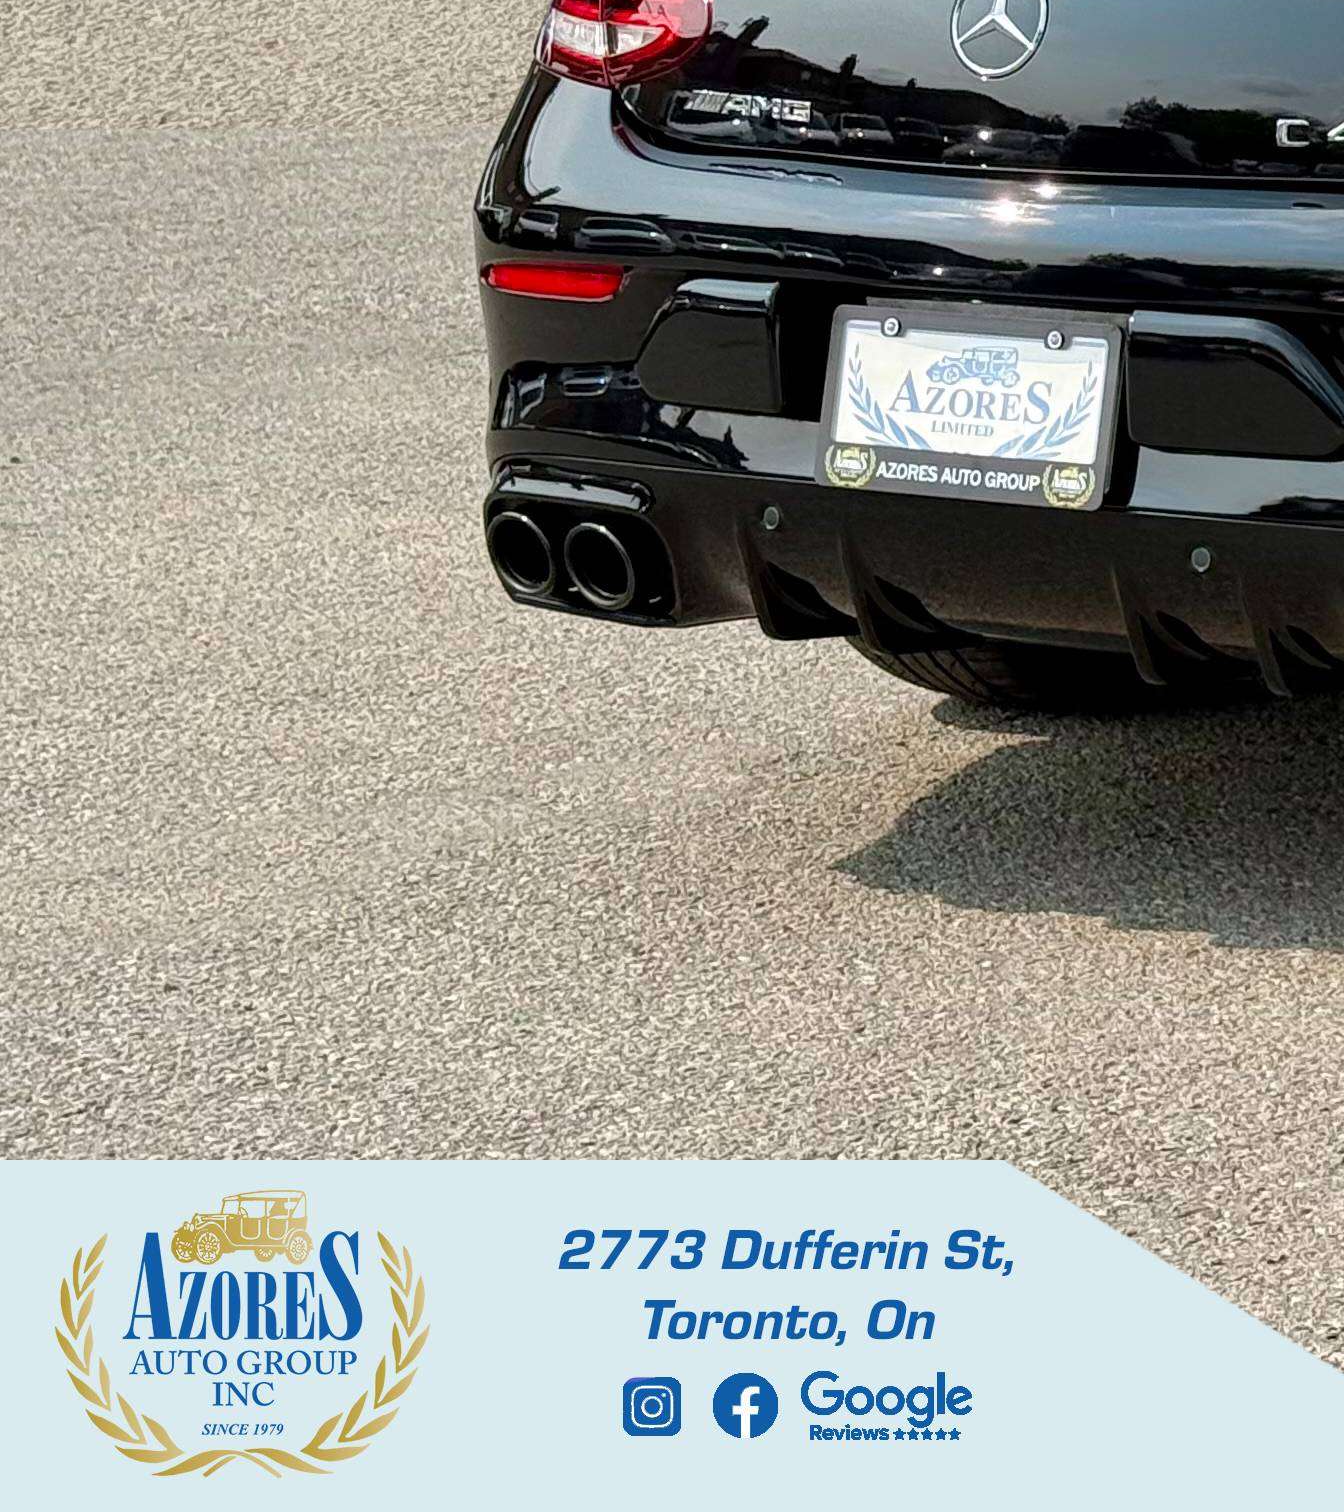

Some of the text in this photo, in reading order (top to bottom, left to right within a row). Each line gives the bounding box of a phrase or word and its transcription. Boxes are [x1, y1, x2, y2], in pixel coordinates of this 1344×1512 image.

[888, 369, 1053, 425] AZORES
[930, 419, 995, 438] LIMITED
[876, 461, 938, 483] AZORES
[941, 467, 982, 487] AUTO
[985, 471, 1041, 492] GROUP
